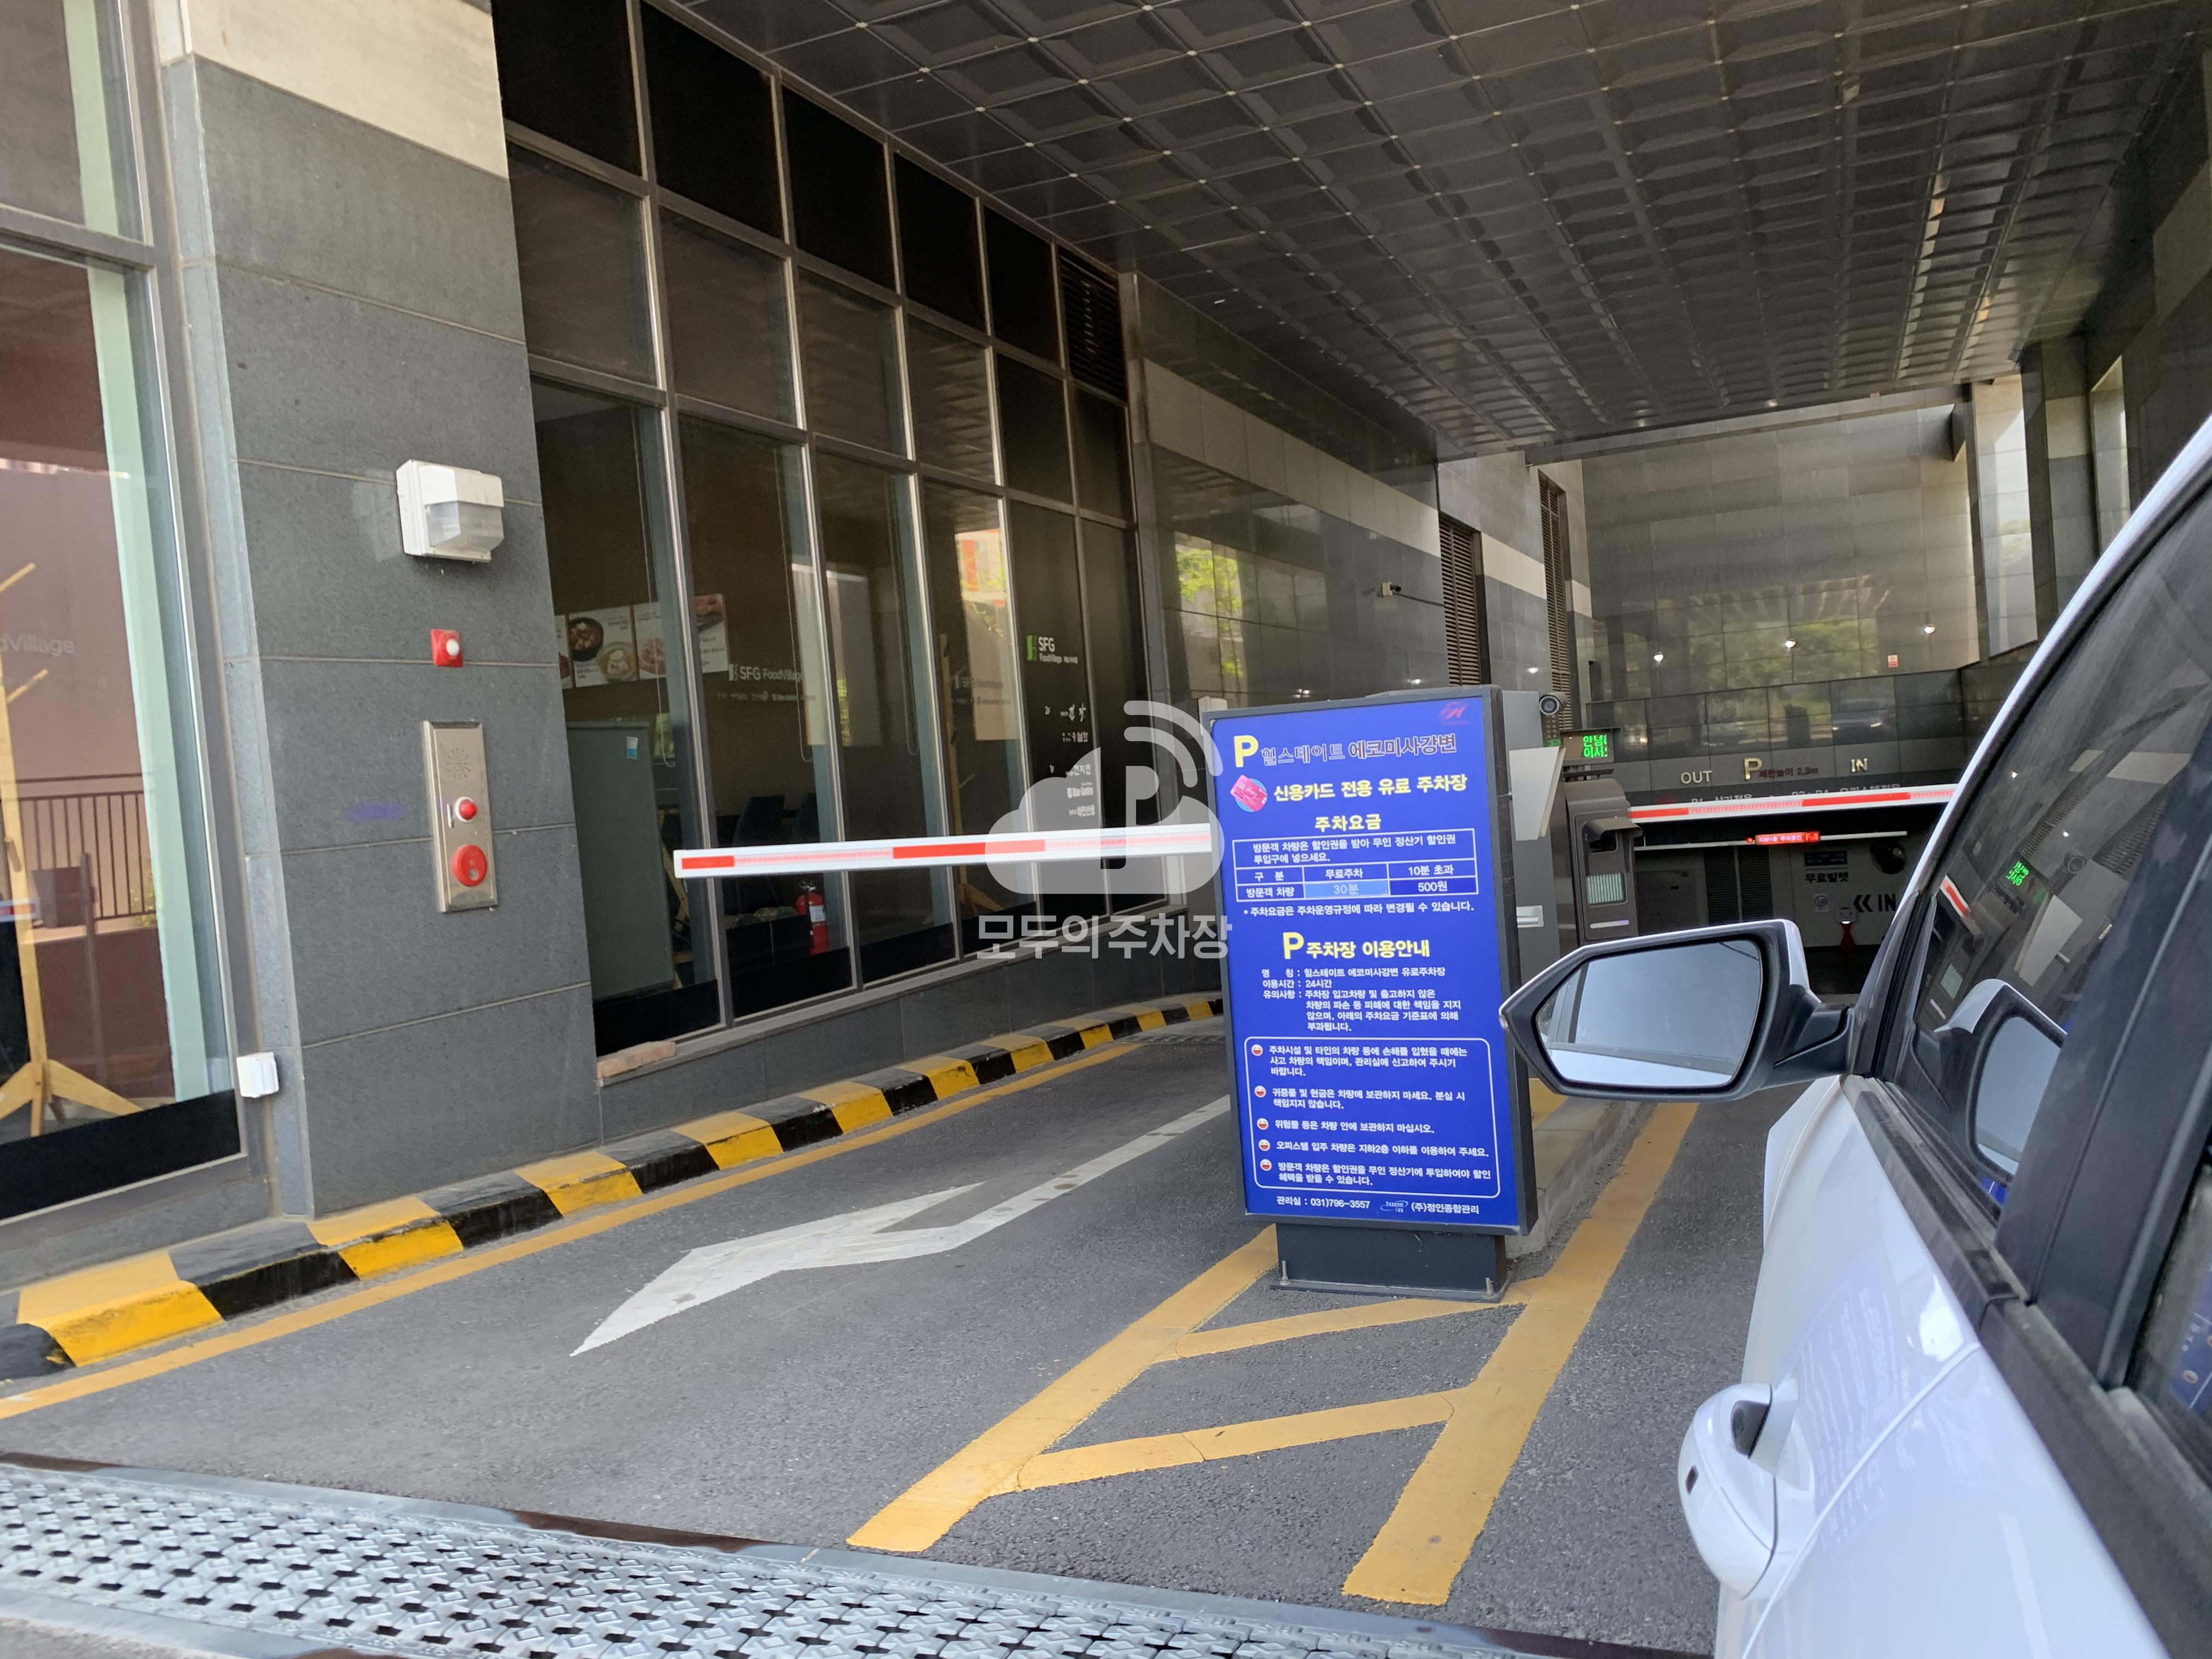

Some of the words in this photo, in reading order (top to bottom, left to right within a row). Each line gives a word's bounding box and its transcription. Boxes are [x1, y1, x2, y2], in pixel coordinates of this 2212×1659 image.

[1038, 636, 1055, 652] SFG
[740, 665, 761, 681] SFG
[1234, 735, 1259, 768] P
[1348, 733, 1457, 760] 에코미사강변
[1584, 747, 1608, 758] 어서
[1743, 757, 1763, 780] P
[1850, 758, 1869, 772] IN
[1680, 770, 1712, 785] OUT
[1273, 783, 1335, 802] 신용카드
[1341, 780, 1373, 798] 전용
[1378, 778, 1412, 795] 유료
[1417, 774, 1468, 793] 주차장
[1314, 814, 1381, 833] 주차요금
[1252, 842, 1279, 854] 방문객
[1282, 840, 1309, 852] 차량은
[1311, 839, 1348, 851] 할인권을
[1351, 838, 1370, 849] 받아
[1372, 837, 1392, 848] 무인
[1395, 835, 1423, 847] 정산기
[1426, 833, 1456, 845] 할인권
[1254, 853, 1289, 865] 투입구에
[1291, 852, 1330, 864] 넣으세요.
[1325, 868, 1364, 879] 무료주차
[1408, 865, 1430, 876] 10분
[1433, 864, 1454, 875] 초과
[1805, 871, 1849, 884] 무료발렛
[1246, 887, 1273, 898] 방문객
[1276, 886, 1295, 897] 차량
[1334, 883, 1359, 895] 30분
[1418, 881, 1448, 892] 500원
[1250, 906, 1295, 917] 주차요금은
[1297, 904, 1361, 916] 주차운영규정에
[1364, 903, 1383, 914] 따라
[1386, 902, 1415, 913] 변경될
[1418, 902, 1429, 912] 수
[1431, 900, 1474, 912] 있습니다.
[1878, 893, 1897, 912] IN
[1283, 932, 1304, 960] P
[1306, 941, 1356, 959] 주차장
[1362, 939, 1430, 958] 이용안내
[1347, 967, 1399, 977] 에코미사강변
[1401, 967, 1446, 977] 유료주차장
[1262, 979, 1295, 989] 이용시간
[1305, 979, 1333, 989] 24시간
[1263, 990, 1296, 1000] 유의사항
[1305, 990, 1330, 999] 주차장
[1332, 989, 1366, 999] 입고차량
[1368, 989, 1378, 999] 및
[1417, 989, 1436, 999] 않은
[1306, 1000, 1331, 1010] 차량의
[1333, 1000, 1351, 1010] 파손
[1352, 1000, 1362, 1010] 등
[1364, 1000, 1390, 1010] 피해에
[1393, 1000, 1411, 1010] 대한
[1413, 1000, 1440, 1010] 책임을
[1443, 1000, 1461, 1010] 지지
[1306, 1011, 1335, 1021] 않으며,
[1337, 1011, 1363, 1021] 아래의
[1365, 1011, 1400, 1021] 주차요금
[1402, 1011, 1437, 1021] 기준표에
[1440, 1011, 1459, 1021] 의해
[1307, 1022, 1352, 1031] 부과됩니다.
[1269, 1046, 1302, 1055] 주차시설
[1304, 1046, 1312, 1055] 및
[1314, 1046, 1340, 1056] 타인의
[1342, 1046, 1360, 1056] 차량
[1362, 1046, 1380, 1056] 등에
[1382, 1046, 1409, 1057] 손해를
[1440, 1047, 1468, 1057] 때에는
[1269, 1056, 1287, 1065] 사고
[1289, 1056, 1313, 1066] 차량의
[1316, 1057, 1352, 1066] 책임이며,
[1355, 1057, 1389, 1067] 관리실에
[1391, 1058, 1426, 1068] 신고하여
[1429, 1058, 1456, 1068] 주시기
[1271, 1066, 1306, 1076] 바랍니다.
[1272, 1087, 1297, 1097] 귀중품
[1299, 1088, 1308, 1098] 및
[1310, 1088, 1335, 1098] 현금은
[1338, 1089, 1363, 1099] 차량에
[1365, 1090, 1400, 1100] 보관하지
[1402, 1091, 1432, 1101] 마세요.
[1435, 1091, 1453, 1101] 분실
[1456, 1091, 1465, 1101] 시
[1273, 1098, 1306, 1109] 책임지지
[1307, 1099, 1344, 1109] 않습니다.
[1275, 1119, 1300, 1130] 위험물
[1301, 1120, 1319, 1130] 등은
[1321, 1121, 1338, 1131] 차량
[1340, 1121, 1357, 1131] 안에
[1359, 1122, 1394, 1132] 보관하지
[1397, 1123, 1435, 1133] 마십시오.
[1276, 1141, 1309, 1151] 오피스텔
[1311, 1142, 1329, 1152] 입주
[1330, 1143, 1356, 1153] 차량은
[1358, 1144, 1390, 1154] 지하2층
[1392, 1145, 1418, 1155] 이하를
[1421, 1146, 1456, 1156] 이용하여
[1458, 1147, 1489, 1157] 주세요.
[1278, 1162, 1303, 1172] 방문객
[1305, 1163, 1330, 1173] 차량은
[1332, 1164, 1366, 1175] 할인권을
[1368, 1166, 1386, 1175] 무인
[1389, 1166, 1423, 1177] 정산기에
[1425, 1168, 1470, 1179] 투입하여야
[1472, 1169, 1491, 1180] 할인
[1306, 1173, 1323, 1183] 받을
[1325, 1175, 1334, 1184] 수
[1336, 1175, 1373, 1186] 있습니다.
[1276, 1196, 1301, 1206] 관리실
[1310, 1198, 1370, 1209] 031)796-3557
[1411, 1201, 1480, 1215] (주)정인종합관리
